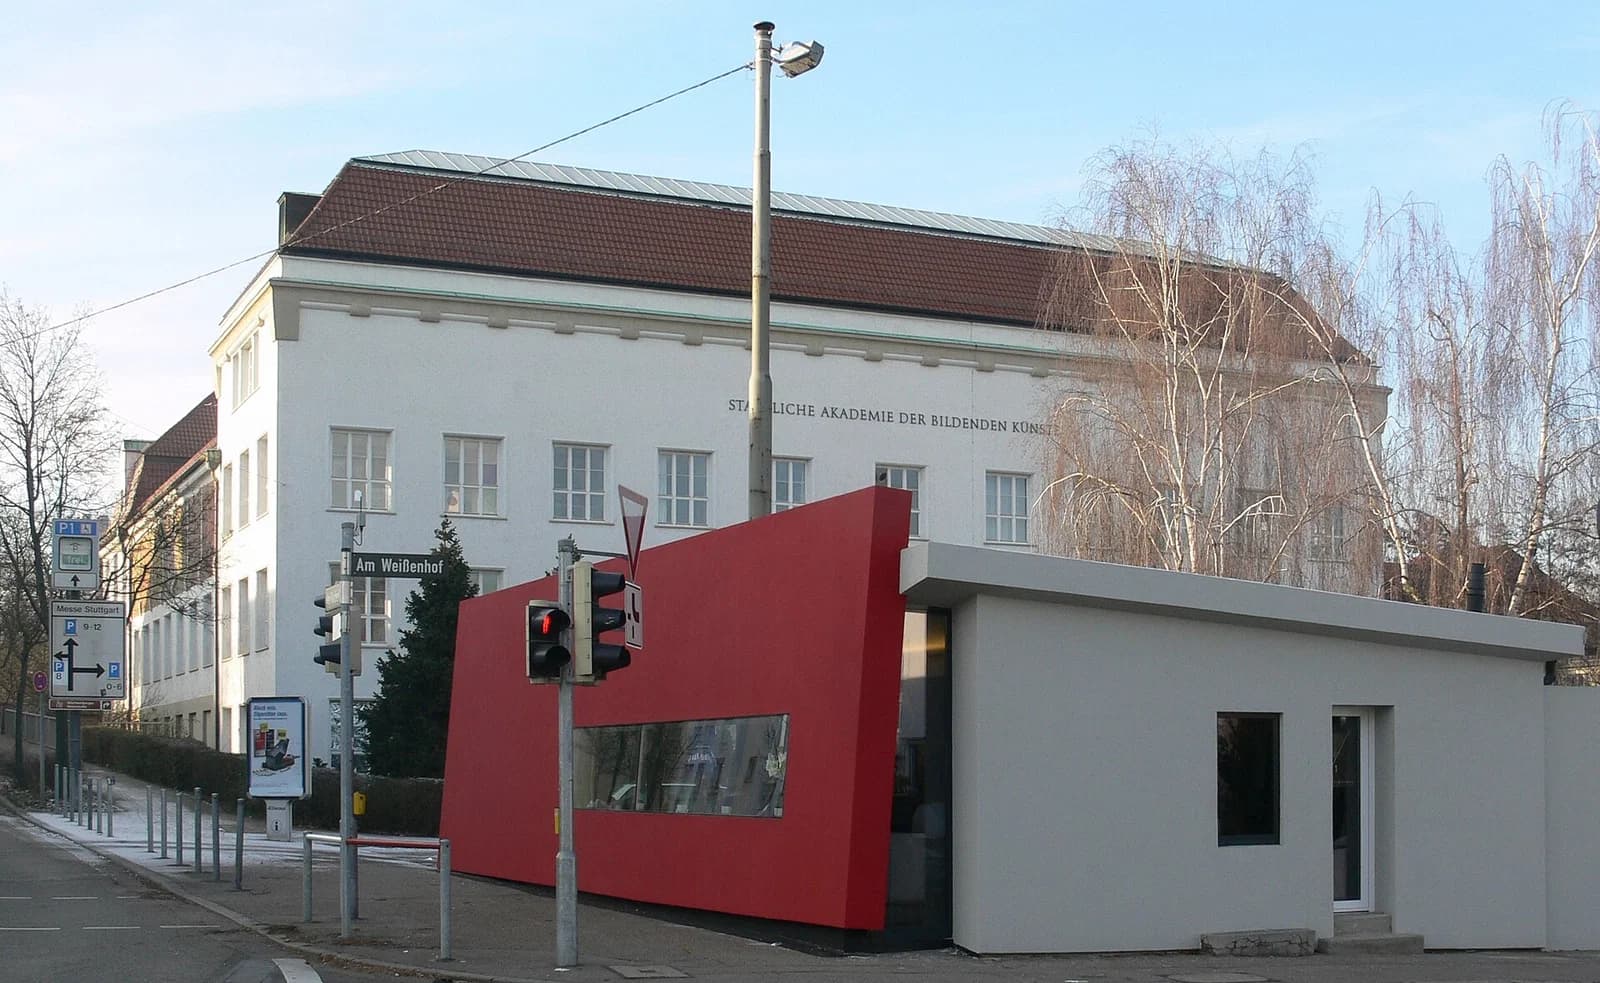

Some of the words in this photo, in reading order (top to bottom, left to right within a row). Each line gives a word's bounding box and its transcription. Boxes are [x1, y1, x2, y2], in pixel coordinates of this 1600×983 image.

[821, 406, 894, 423] AKADEMIE
[899, 412, 926, 426] DER
[931, 414, 1007, 432] BILDENDEN
[59, 522, 75, 534] P1
[356, 557, 375, 572] Am
[381, 558, 444, 574] Weißenhof
[56, 605, 82, 613] Messe
[85, 605, 119, 615] Stuttgart
[67, 621, 74, 630] P
[55, 663, 63, 671] P
[110, 665, 118, 673] P
